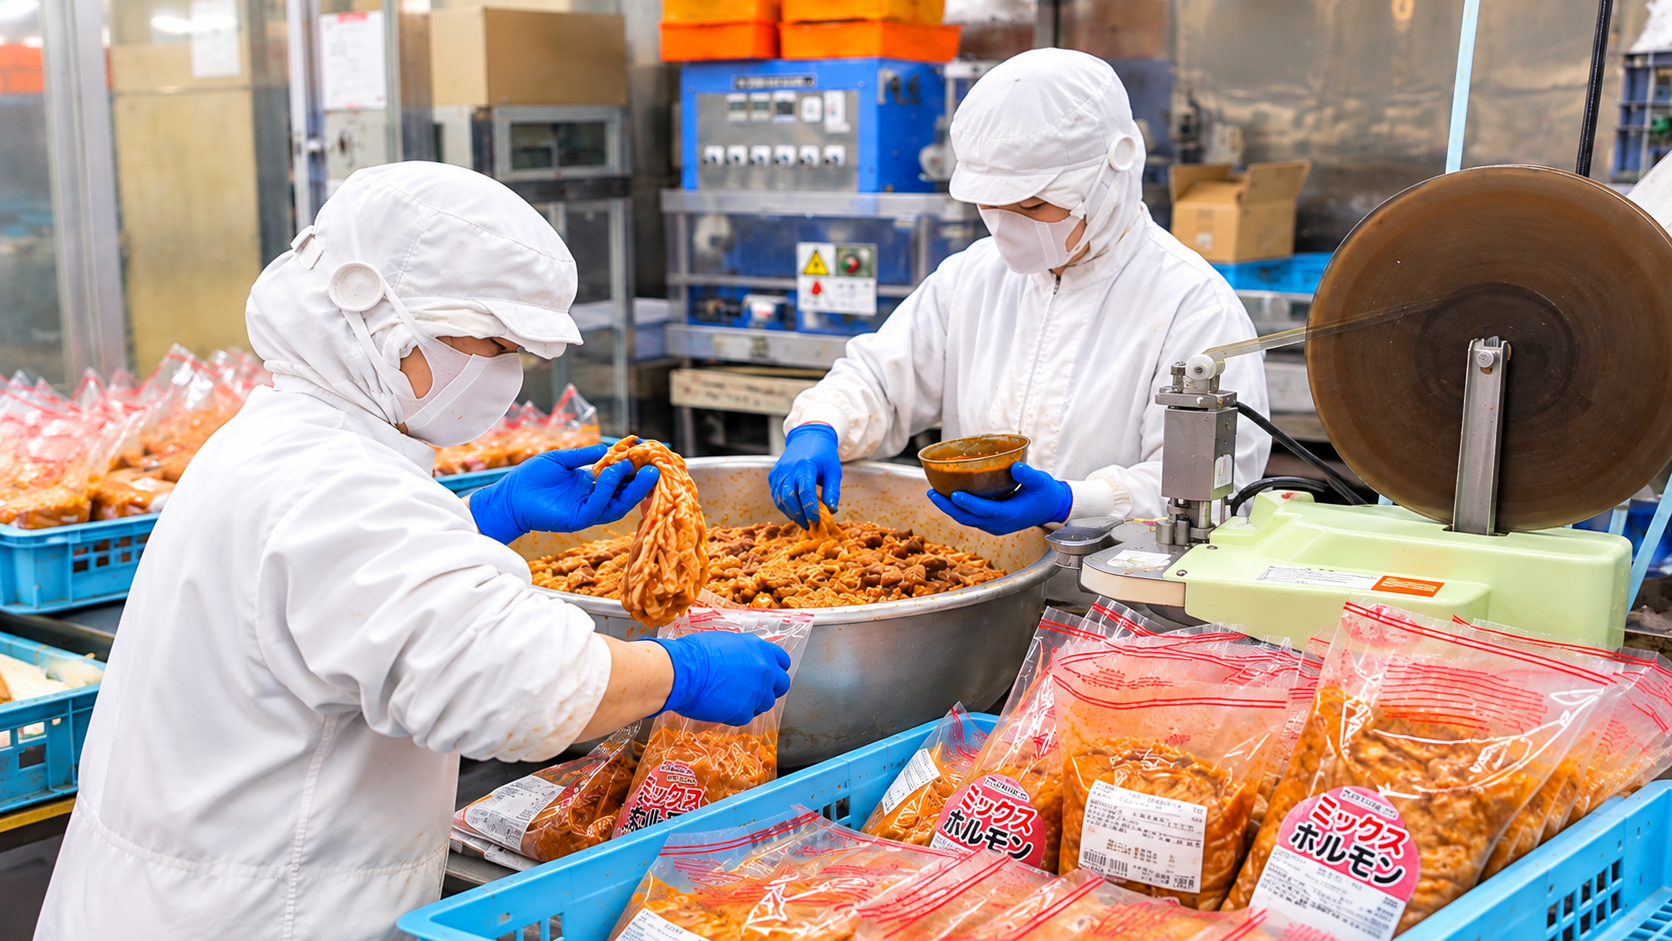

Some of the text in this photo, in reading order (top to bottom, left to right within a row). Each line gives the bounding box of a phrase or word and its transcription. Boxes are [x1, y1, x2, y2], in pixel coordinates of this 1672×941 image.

[943, 809, 1032, 859] ホルモン
[961, 784, 1036, 834] ミックス
[1311, 795, 1406, 856] ミックス
[1290, 823, 1403, 884] ホルモン
